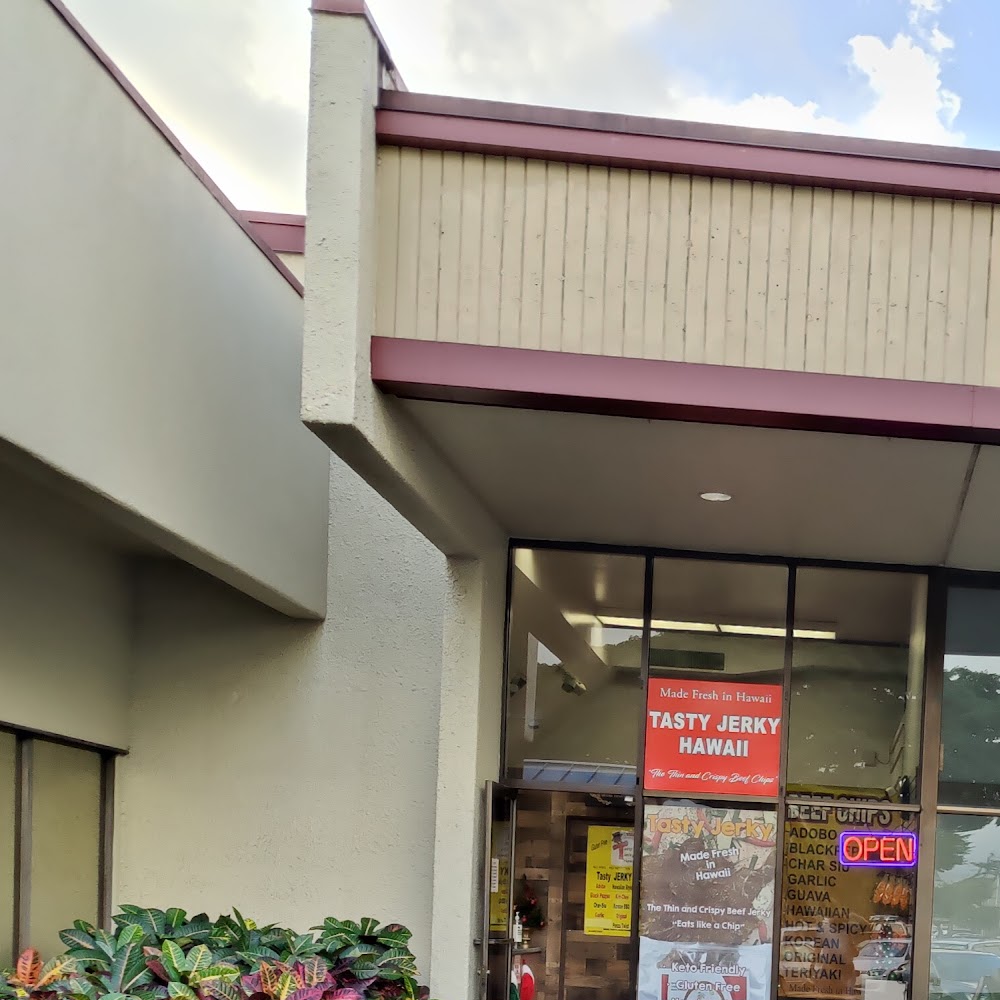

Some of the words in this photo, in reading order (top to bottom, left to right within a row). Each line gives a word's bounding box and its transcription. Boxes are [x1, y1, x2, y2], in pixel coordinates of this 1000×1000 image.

[660, 688, 688, 699] Made
[692, 690, 718, 700] Fresh
[722, 692, 732, 702] in
[736, 692, 772, 704] Hawaii
[649, 710, 711, 731] TASTY
[716, 715, 780, 735] JERKY
[679, 736, 748, 757] HAWAII
[668, 769, 684, 779] Thin
[685, 771, 701, 779] and
[702, 772, 727, 783] Crispy
[729, 772, 751, 784] Beef
[648, 814, 704, 838] Tasty
[711, 818, 772, 841] Jerky
[789, 828, 838, 840] ADOBO
[680, 850, 709, 862] Made
[712, 847, 739, 858] Fresh
[843, 836, 912, 862] OPEN
[706, 860, 716, 869] in
[788, 858, 824, 871] CHAR
[596, 872, 611, 882] Tasty
[614, 872, 632, 882] JERKY
[696, 868, 732, 880] Hawaii
[788, 874, 836, 887] GARLIC
[787, 890, 831, 902] GUAVA
[647, 904, 662, 912] The
[664, 904, 680, 912] Thin
[682, 904, 697, 913] and
[698, 906, 725, 916] Crispy
[726, 907, 746, 916] Beef
[748, 908, 771, 918] Jerky
[786, 904, 850, 919] HAWAIIAN
[829, 922, 868, 935] SPICY
[784, 936, 840, 949] KOREAN
[784, 951, 846, 964] ORIGINAL
[672, 962, 697, 972] Keto
[700, 964, 746, 976] Friendly
[784, 966, 842, 980] TERIYAKI
[676, 980, 712, 991] Gluten
[716, 982, 740, 992] Free
